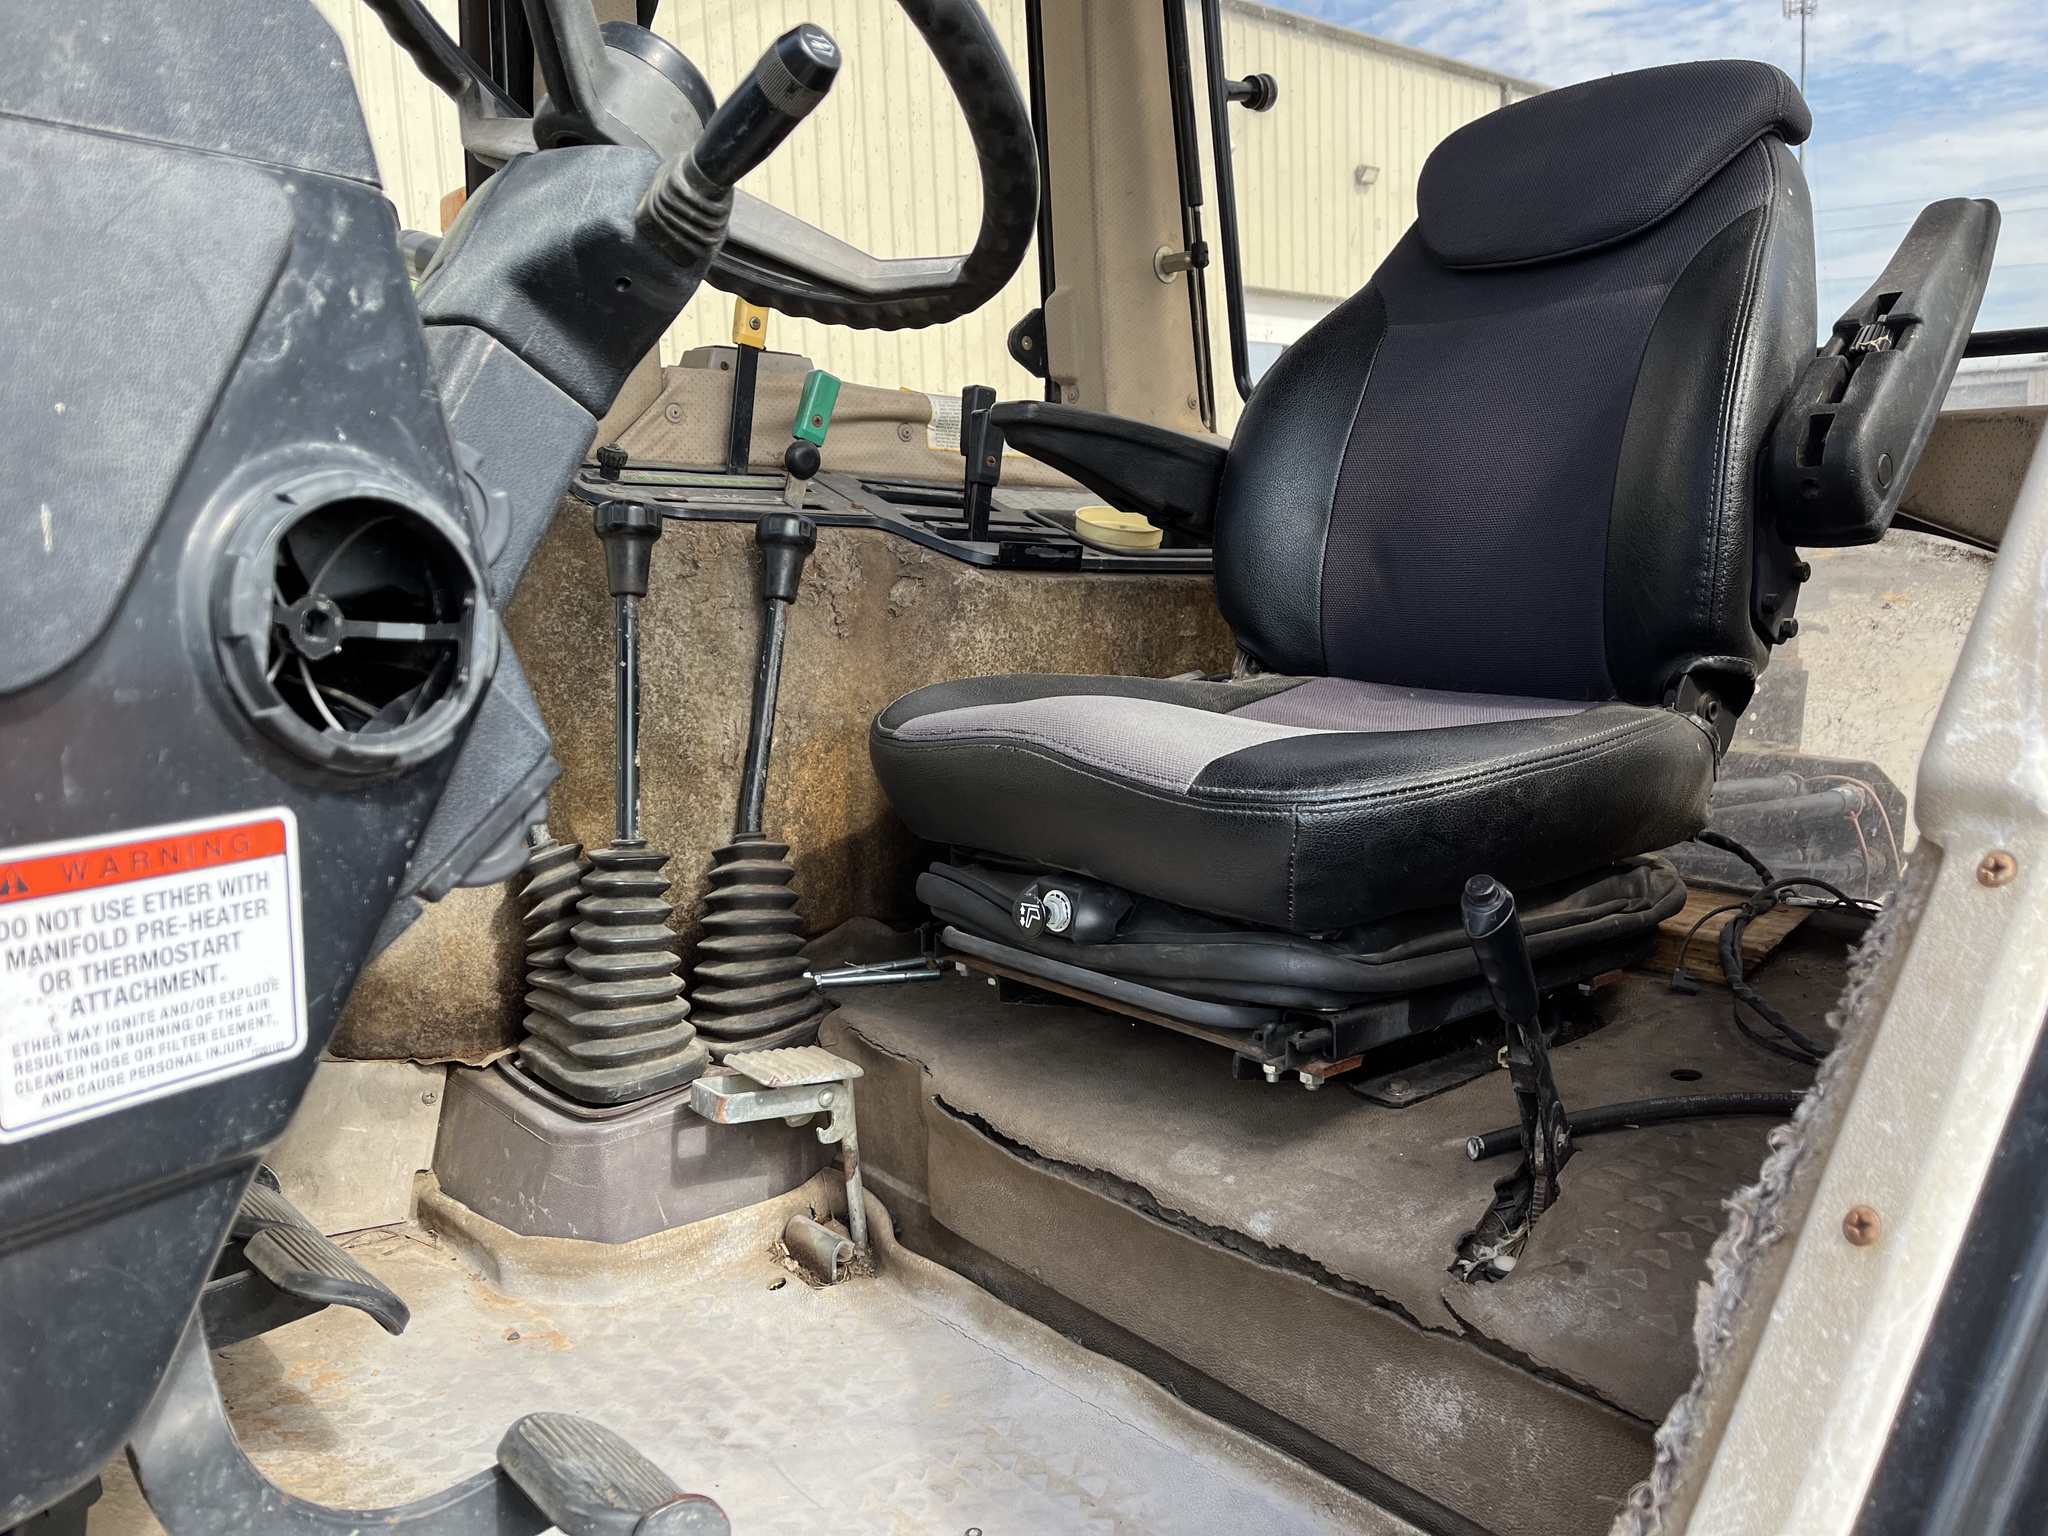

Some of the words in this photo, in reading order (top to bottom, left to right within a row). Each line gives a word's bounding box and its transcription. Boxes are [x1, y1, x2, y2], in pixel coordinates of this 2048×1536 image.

[59, 833, 250, 882] WARNING
[36, 905, 82, 935] NOT
[91, 896, 135, 924] USE
[142, 882, 212, 914] ETHER
[218, 870, 269, 898] WITH
[5, 926, 128, 972] MANIFOLD
[136, 898, 268, 944] PRE-HEATER
[39, 968, 72, 995] OR
[78, 931, 242, 985] THERMOSTART
[12, 1033, 62, 1058] ETHER
[67, 1024, 100, 1045] MAY
[106, 1010, 155, 1034] IGNITE
[160, 995, 215, 1020] AND/OR
[220, 979, 280, 1005] EXPLODE
[69, 963, 228, 1019] ATTACHMENT.
[14, 1042, 102, 1076] RESULTING
[106, 1036, 120, 1051] IN
[126, 1018, 191, 1047] BURNING
[196, 1011, 213, 1028] OF
[217, 1004, 243, 1022] THE
[247, 997, 270, 1014] AIR
[15, 1065, 86, 1096] CLEANER
[90, 1052, 130, 1075] HOSE
[134, 1045, 154, 1062] OR
[158, 1031, 206, 1055] FILTER
[41, 1087, 71, 1108] AND
[77, 1072, 125, 1096] CAUSE
[129, 1054, 202, 1081] PERSONAL
[205, 1036, 258, 1059] INJURY.
[1650, 1095, 1688, 1105] Systems
[1729, 1093, 1750, 1101] Fuel
[1753, 1093, 1769, 1101] For
